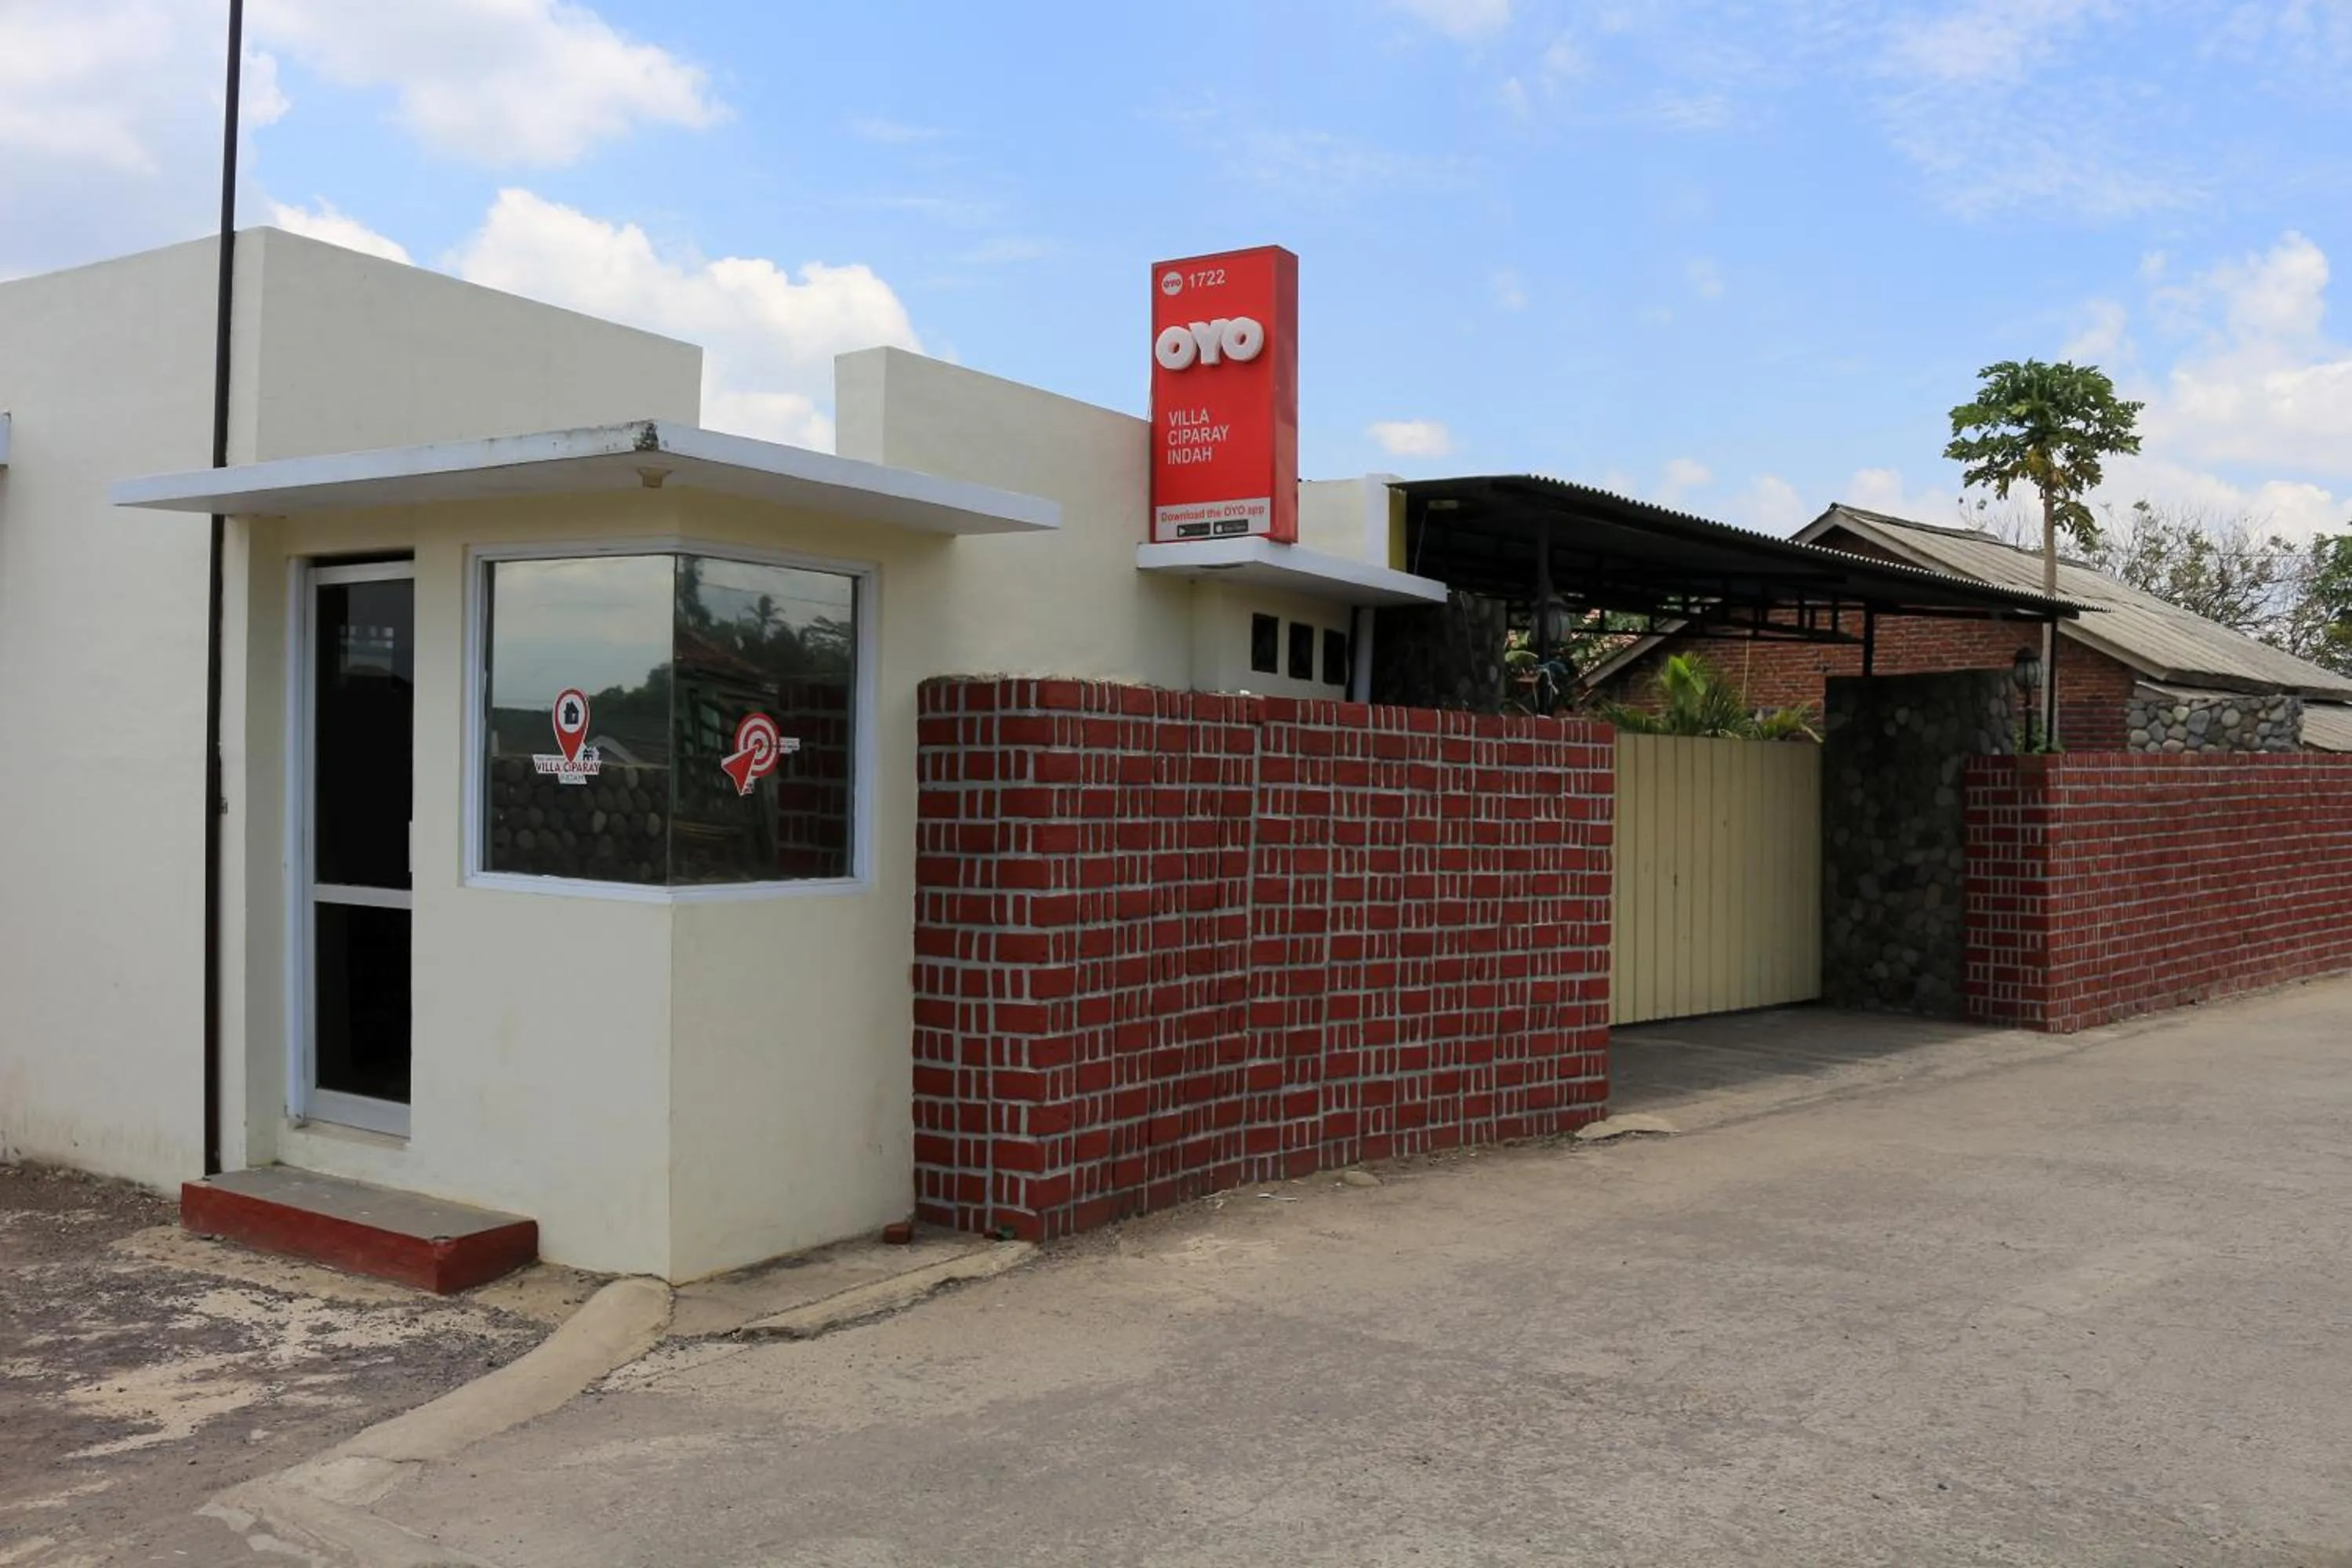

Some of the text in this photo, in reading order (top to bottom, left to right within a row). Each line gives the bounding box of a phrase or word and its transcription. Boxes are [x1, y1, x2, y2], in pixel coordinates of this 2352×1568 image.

[1189, 269, 1225, 289] 1722
[1156, 316, 1265, 370] OYO
[1168, 408, 1210, 426] VILLA
[1167, 425, 1229, 445] CIPARAY
[1167, 447, 1212, 464] INDAH
[1161, 505, 1265, 522] Download the OYO app
[535, 761, 600, 772] VILLA CIPARAY
